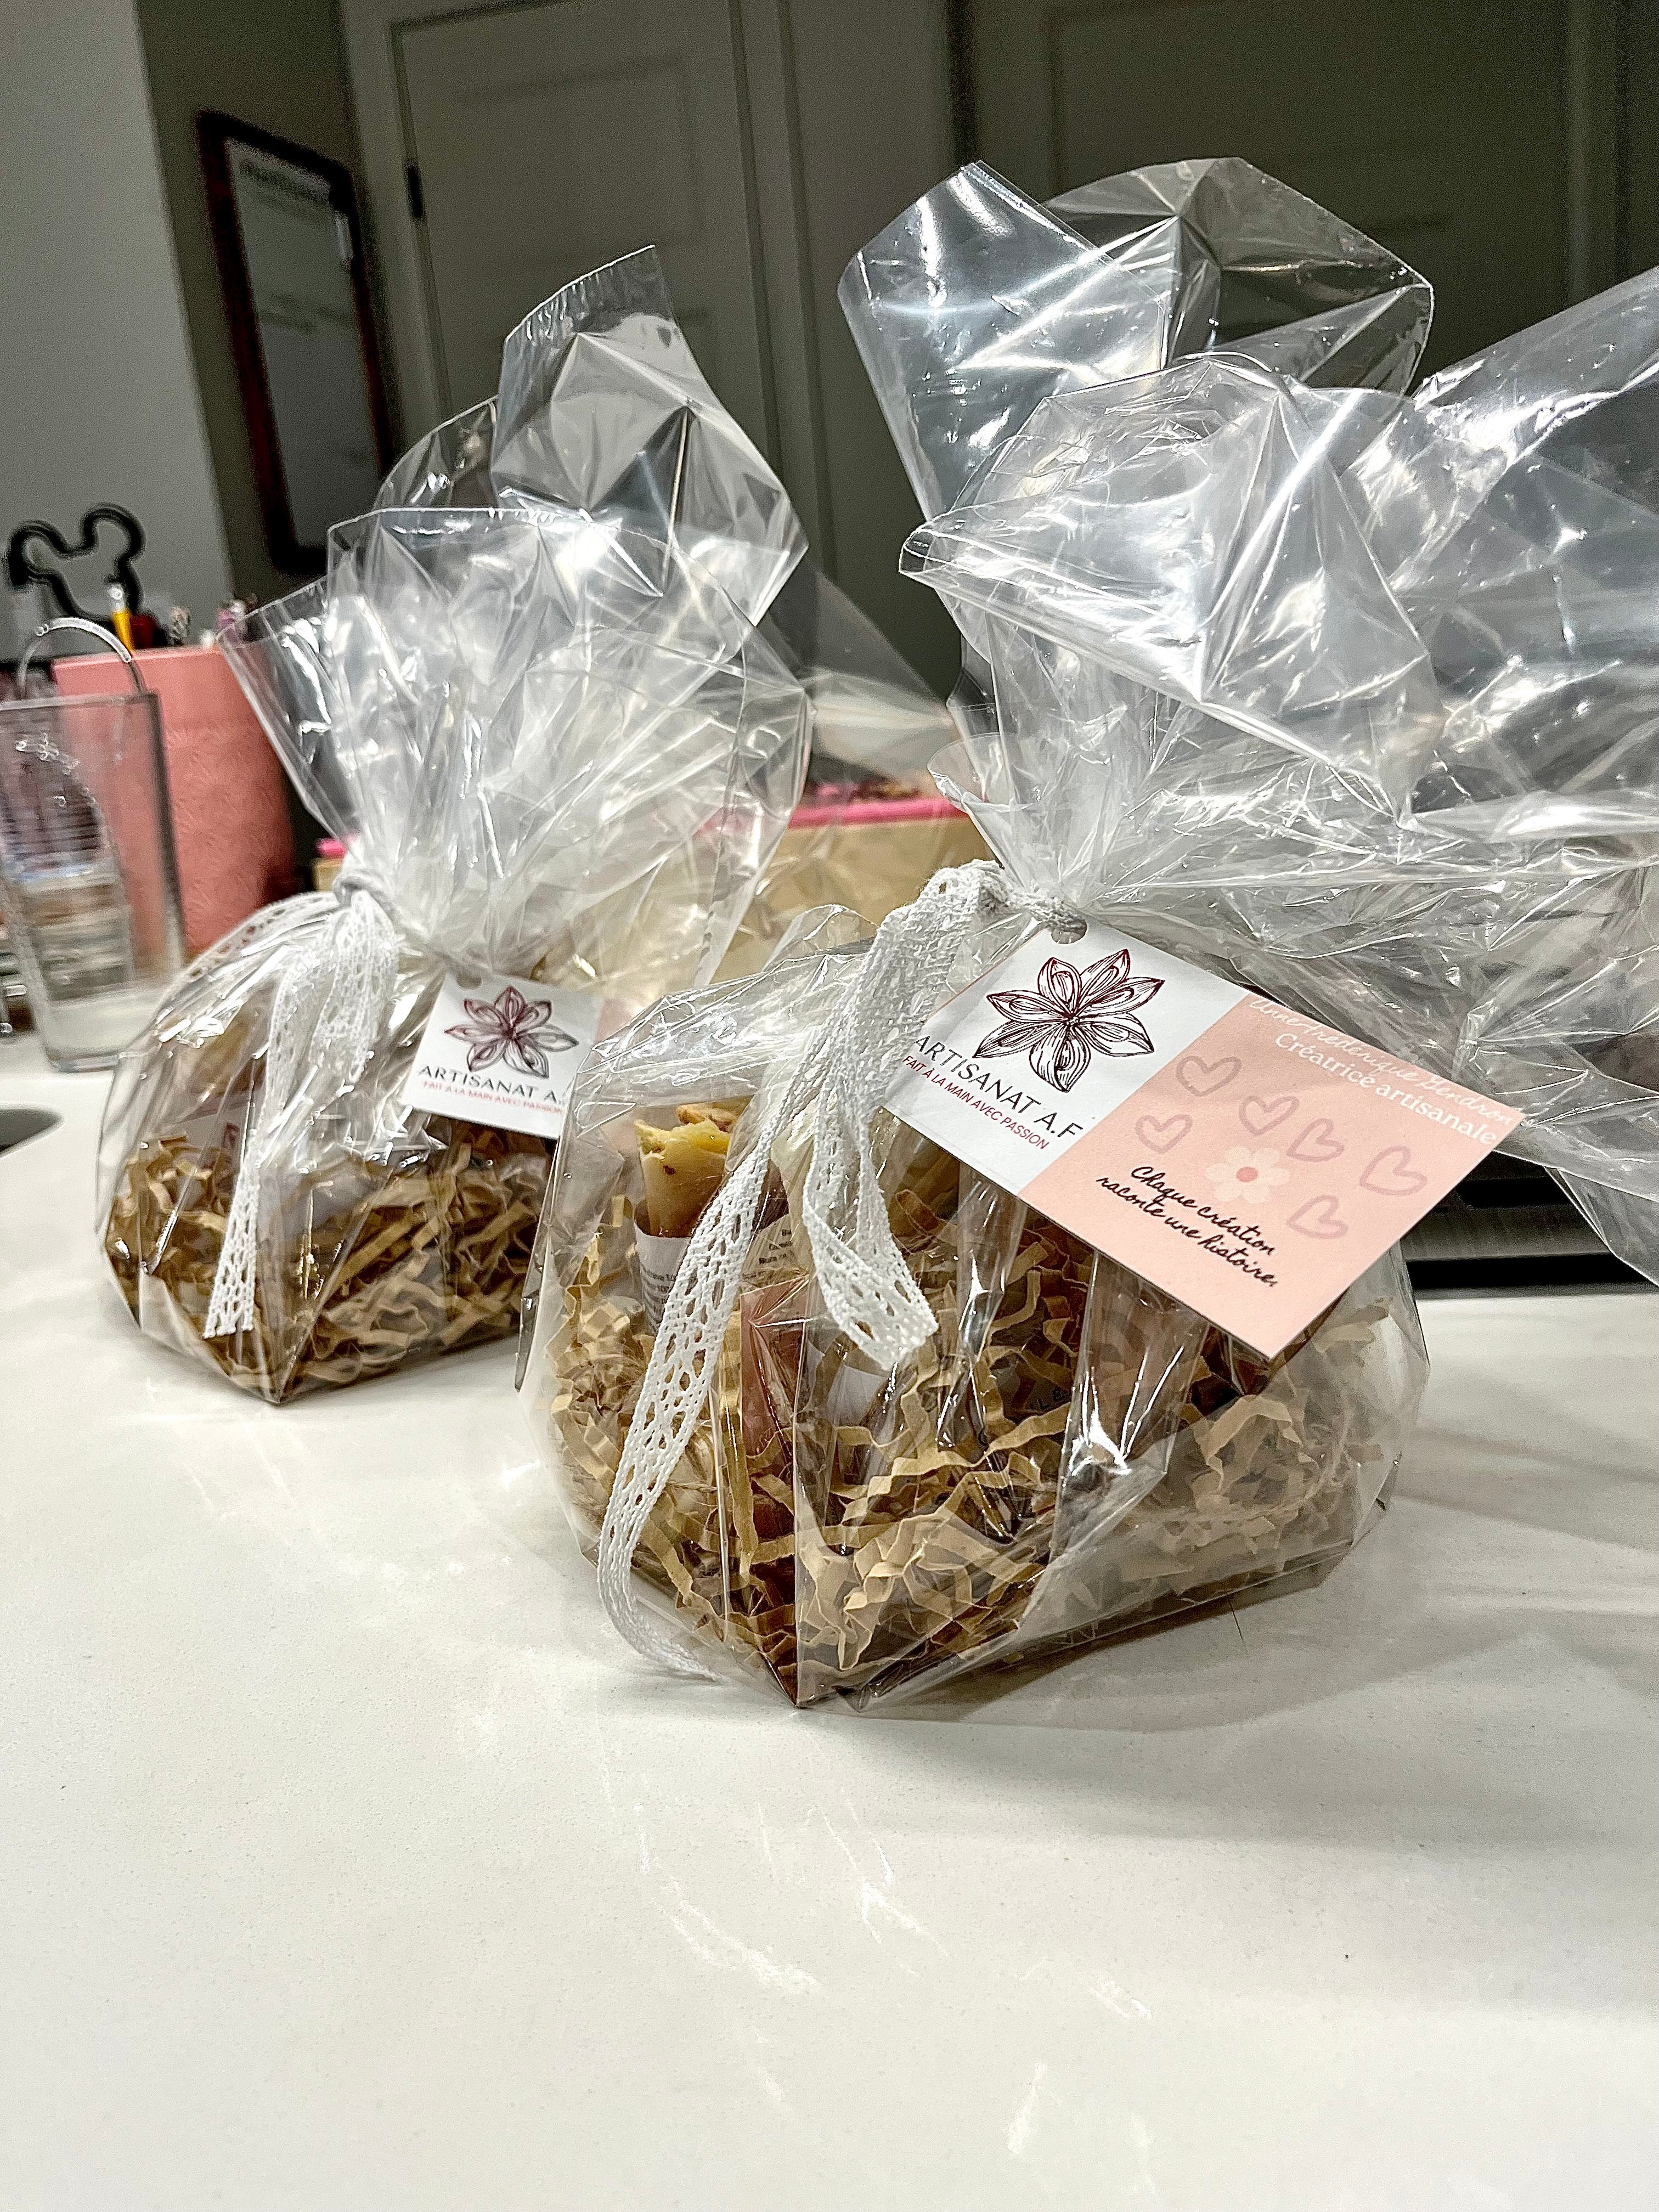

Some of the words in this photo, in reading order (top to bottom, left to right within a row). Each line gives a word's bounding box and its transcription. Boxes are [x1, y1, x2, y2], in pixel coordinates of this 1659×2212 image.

[419, 1065, 539, 1098] ARTISANAT
[902, 1056, 927, 1072] FAIT
[923, 1068, 936, 1079] À
[931, 1074, 947, 1087] LA
[944, 1082, 975, 1103] MAIN
[970, 1100, 1003, 1121] AVEC
[1000, 1116, 1051, 1150] PASSION
[915, 1036, 1042, 1114] ARTISANAT
[1033, 1112, 1084, 1138] A.F
[1275, 1033, 1376, 1088] Créatrice
[1374, 1084, 1498, 1146] artisanale
[1096, 1177, 1165, 1217] raconte
[1164, 1216, 1201, 1239] une
[1131, 1166, 1198, 1208] Chaque
[1197, 1206, 1276, 1256] création
